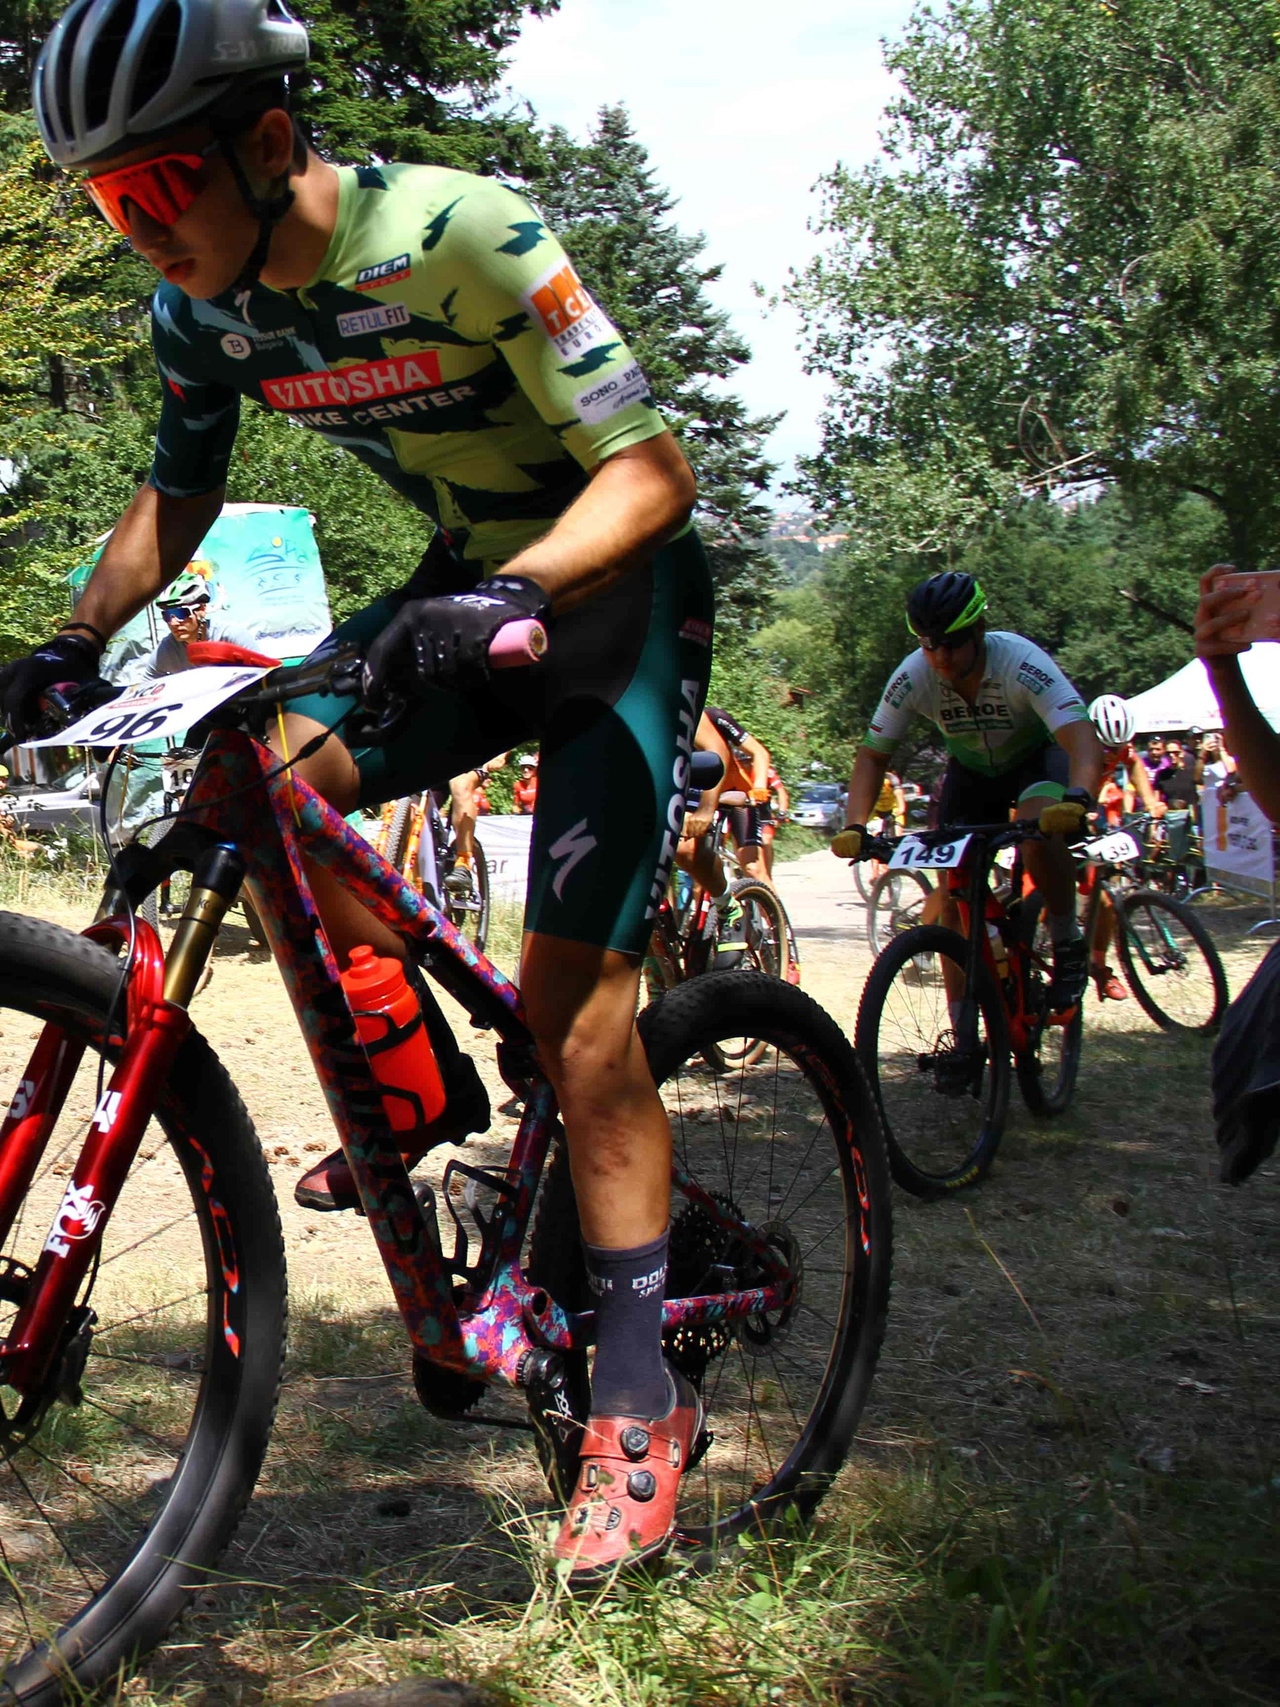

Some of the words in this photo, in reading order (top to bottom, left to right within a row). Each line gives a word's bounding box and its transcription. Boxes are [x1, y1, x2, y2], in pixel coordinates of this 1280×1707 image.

[358, 256, 408, 282] DIEM
[270, 361, 432, 407] VITOSHA
[580, 381, 618, 407] SONO
[353, 385, 477, 426] CENTER
[1020, 661, 1055, 688] BEROE
[73, 703, 183, 744] 96
[941, 703, 1008, 721] BEROE
[900, 844, 956, 865] 149
[43, 1180, 96, 1259] FOX
[632, 1263, 669, 1291] DOL
